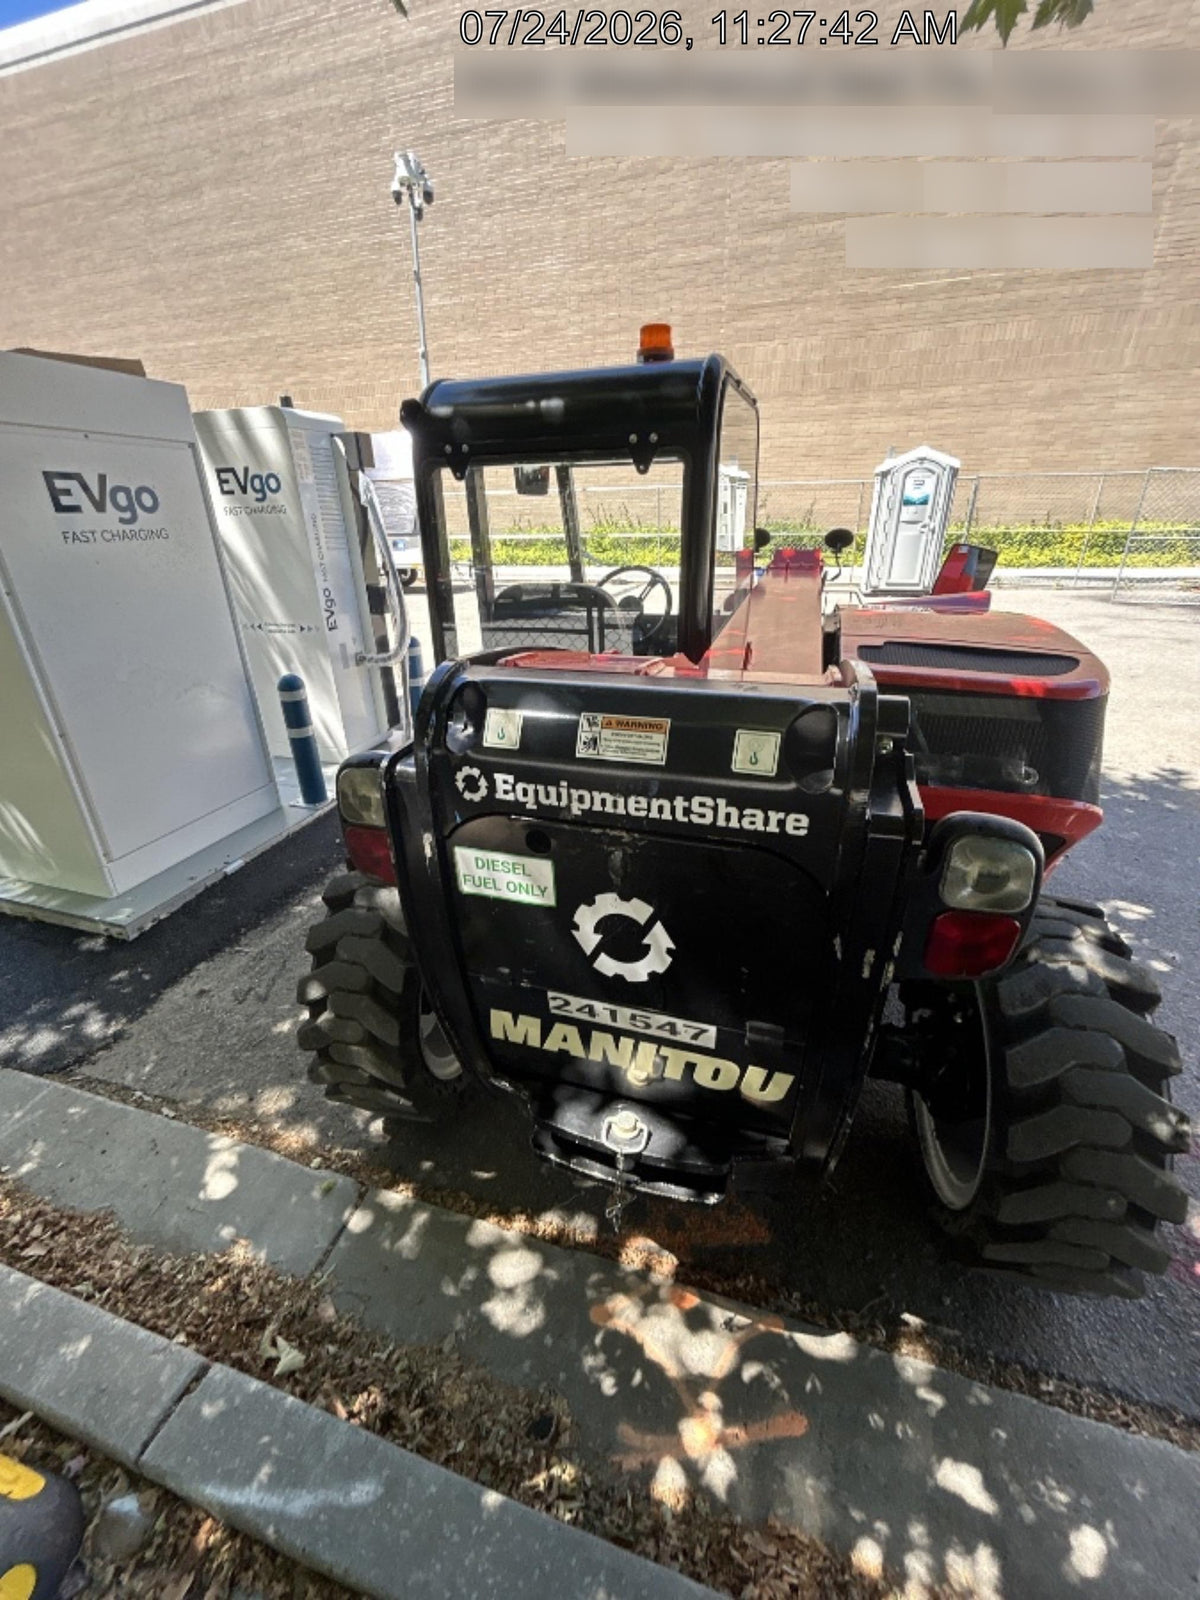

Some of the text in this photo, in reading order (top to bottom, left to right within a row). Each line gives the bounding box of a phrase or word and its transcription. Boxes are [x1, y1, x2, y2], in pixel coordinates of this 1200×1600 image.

[42, 471, 160, 525] EVgo
[214, 466, 281, 502] EVgo
[62, 527, 170, 544] FAST CHARGING
[322, 587, 338, 632] EVgo
[616, 720, 664, 730] WARNING
[493, 772, 810, 837] EquipmentShare
[462, 873, 549, 899] FUEL ONLY
[475, 856, 532, 878] DIESEL
[549, 996, 710, 1041] 241547
[490, 1008, 796, 1102] MANITOU
